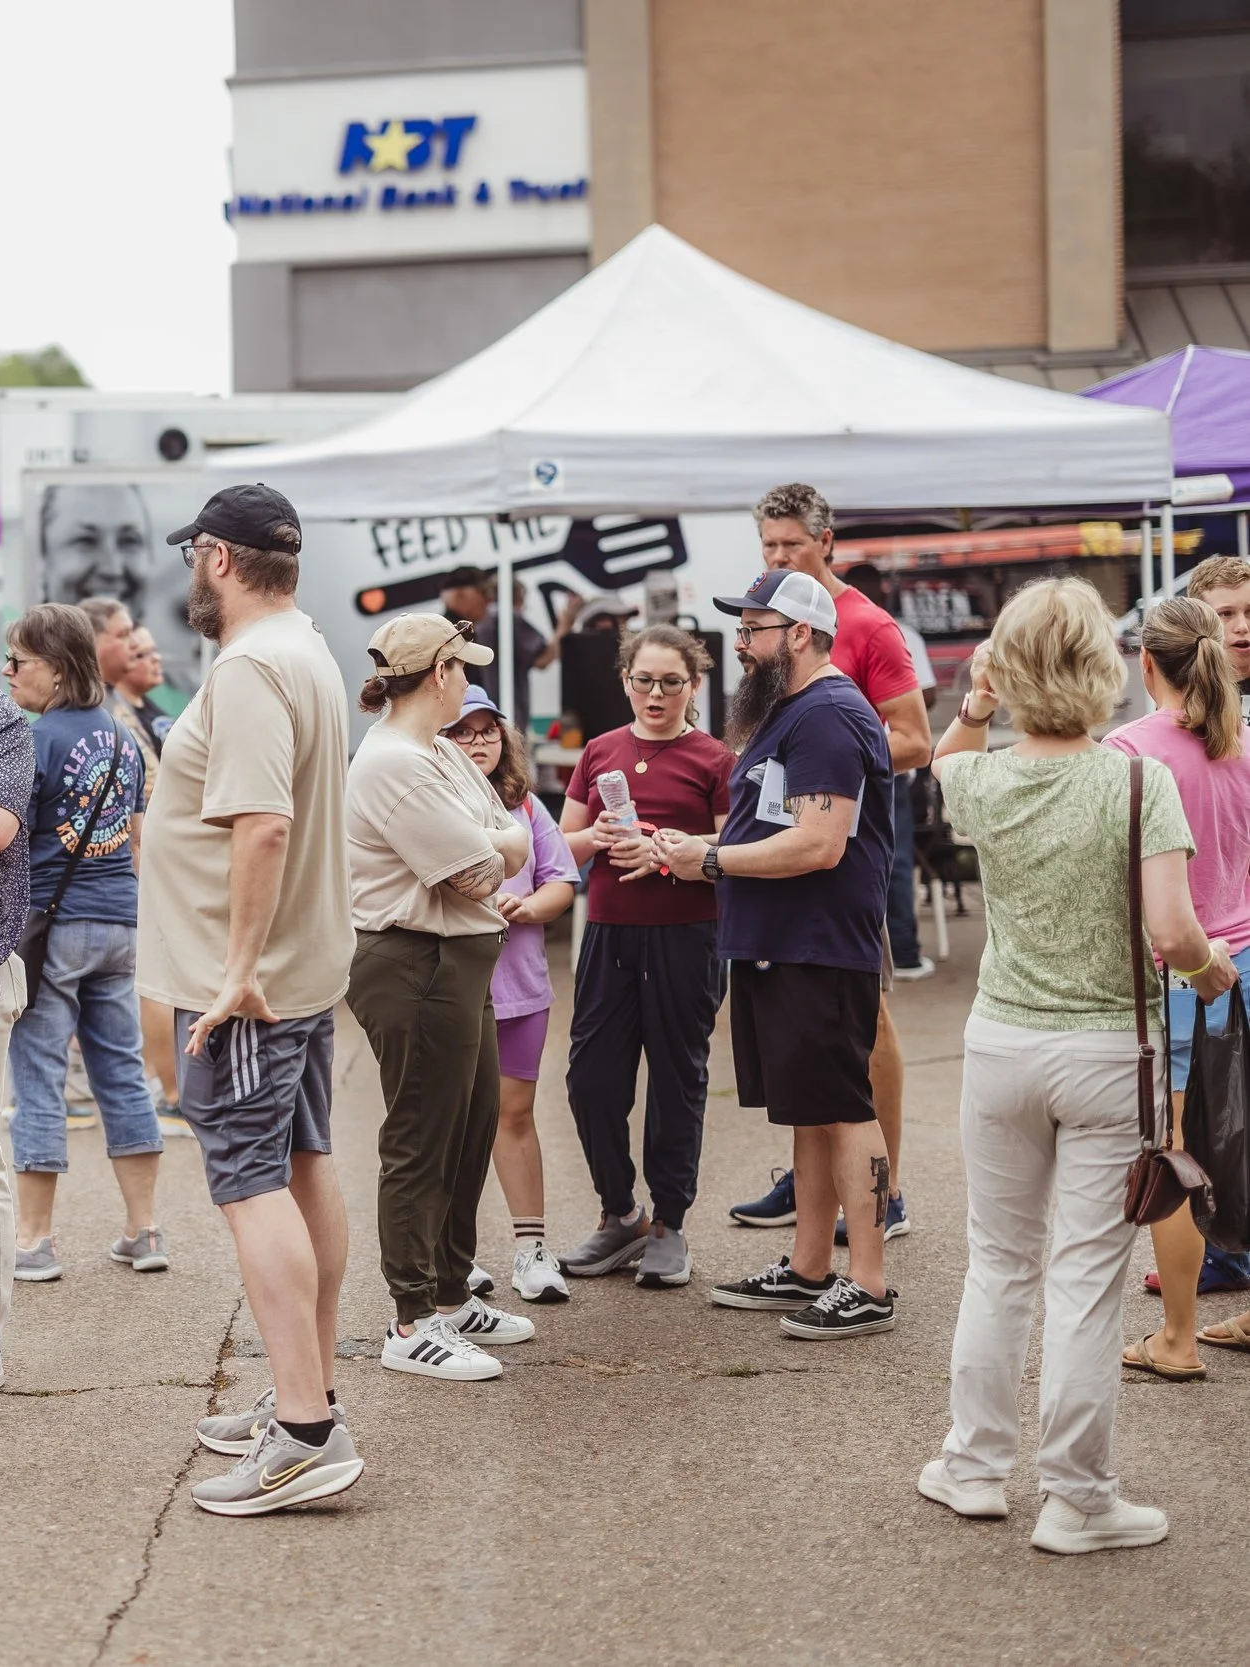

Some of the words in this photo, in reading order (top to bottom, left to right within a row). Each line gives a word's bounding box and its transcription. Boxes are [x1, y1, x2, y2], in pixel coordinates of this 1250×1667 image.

[237, 188, 367, 216] National
[377, 184, 456, 211] Bank
[508, 177, 588, 206] Trust
[370, 516, 469, 568] FEED
[63, 737, 92, 775] LET
[92, 729, 136, 763] THM
[86, 759, 111, 791] JUDGE
[115, 767, 130, 786] OU
